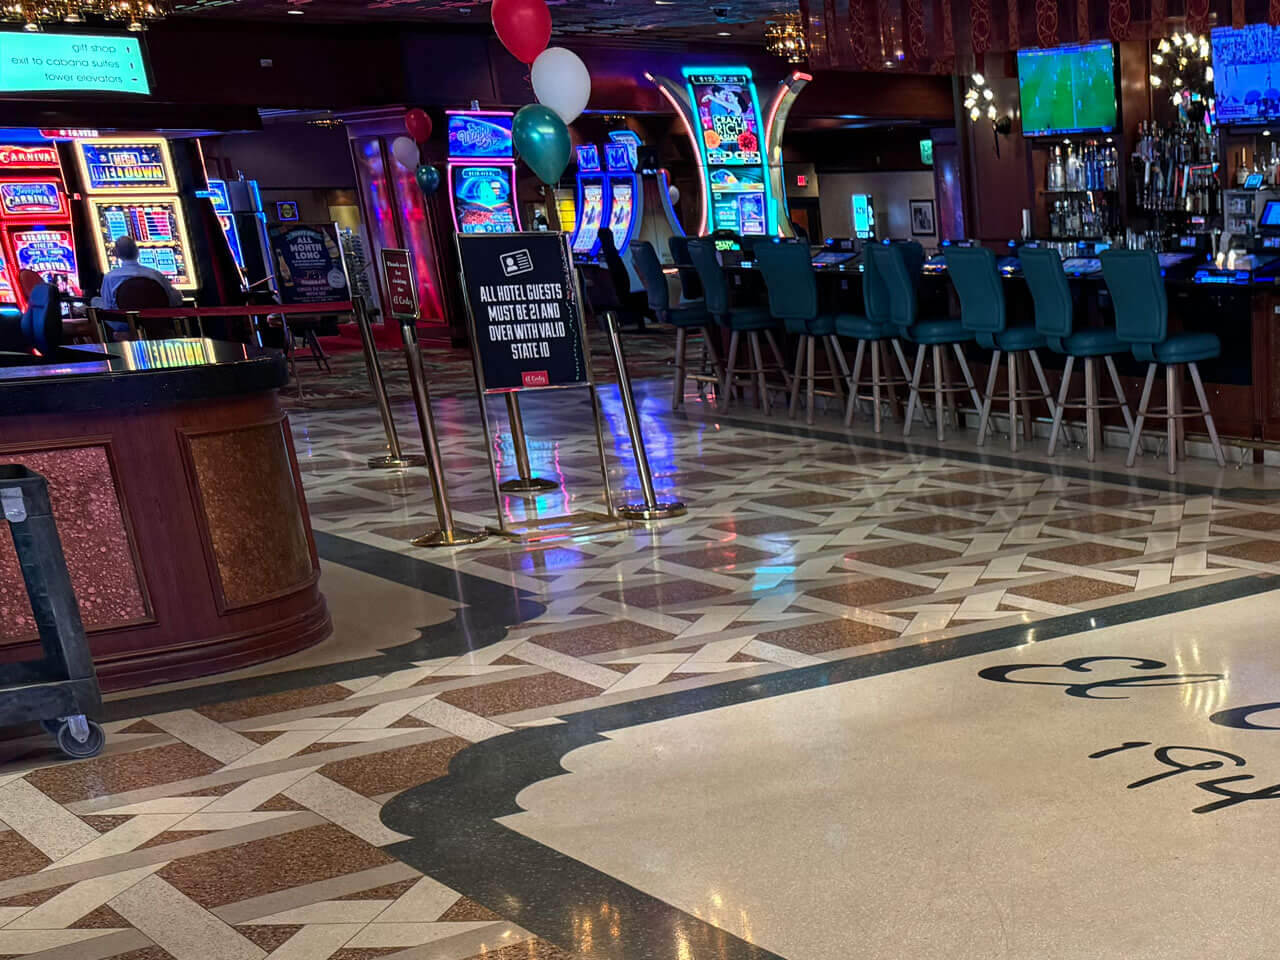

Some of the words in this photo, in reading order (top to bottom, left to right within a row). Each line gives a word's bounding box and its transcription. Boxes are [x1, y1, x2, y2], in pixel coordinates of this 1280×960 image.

[72, 44, 87, 54] gift
[90, 44, 116, 54] shop
[46, 58, 89, 67] cabana
[91, 60, 120, 68] suites
[45, 73, 73, 81] tower
[76, 75, 123, 83] elevators
[715, 115, 742, 124] CRAZY
[717, 123, 744, 136] RICH
[113, 153, 137, 165] MEGA
[91, 165, 164, 180] MELTDOWN
[6, 192, 57, 208] CARNIVAL
[298, 236, 313, 244] ALL
[290, 243, 322, 252] MONTH
[295, 251, 321, 260] LONG
[480, 285, 498, 302] ALL
[498, 284, 527, 302] HOTEL
[527, 283, 563, 301] GUESTS
[488, 304, 515, 322] MUST
[516, 303, 529, 320] BE
[529, 303, 541, 320] 21
[541, 302, 561, 319] AND
[489, 323, 515, 342] OVER
[513, 323, 540, 340] WITH
[538, 321, 566, 339] VALID
[511, 342, 540, 360] STATE
[539, 341, 550, 357] ID
[978, 656, 1227, 699] El
